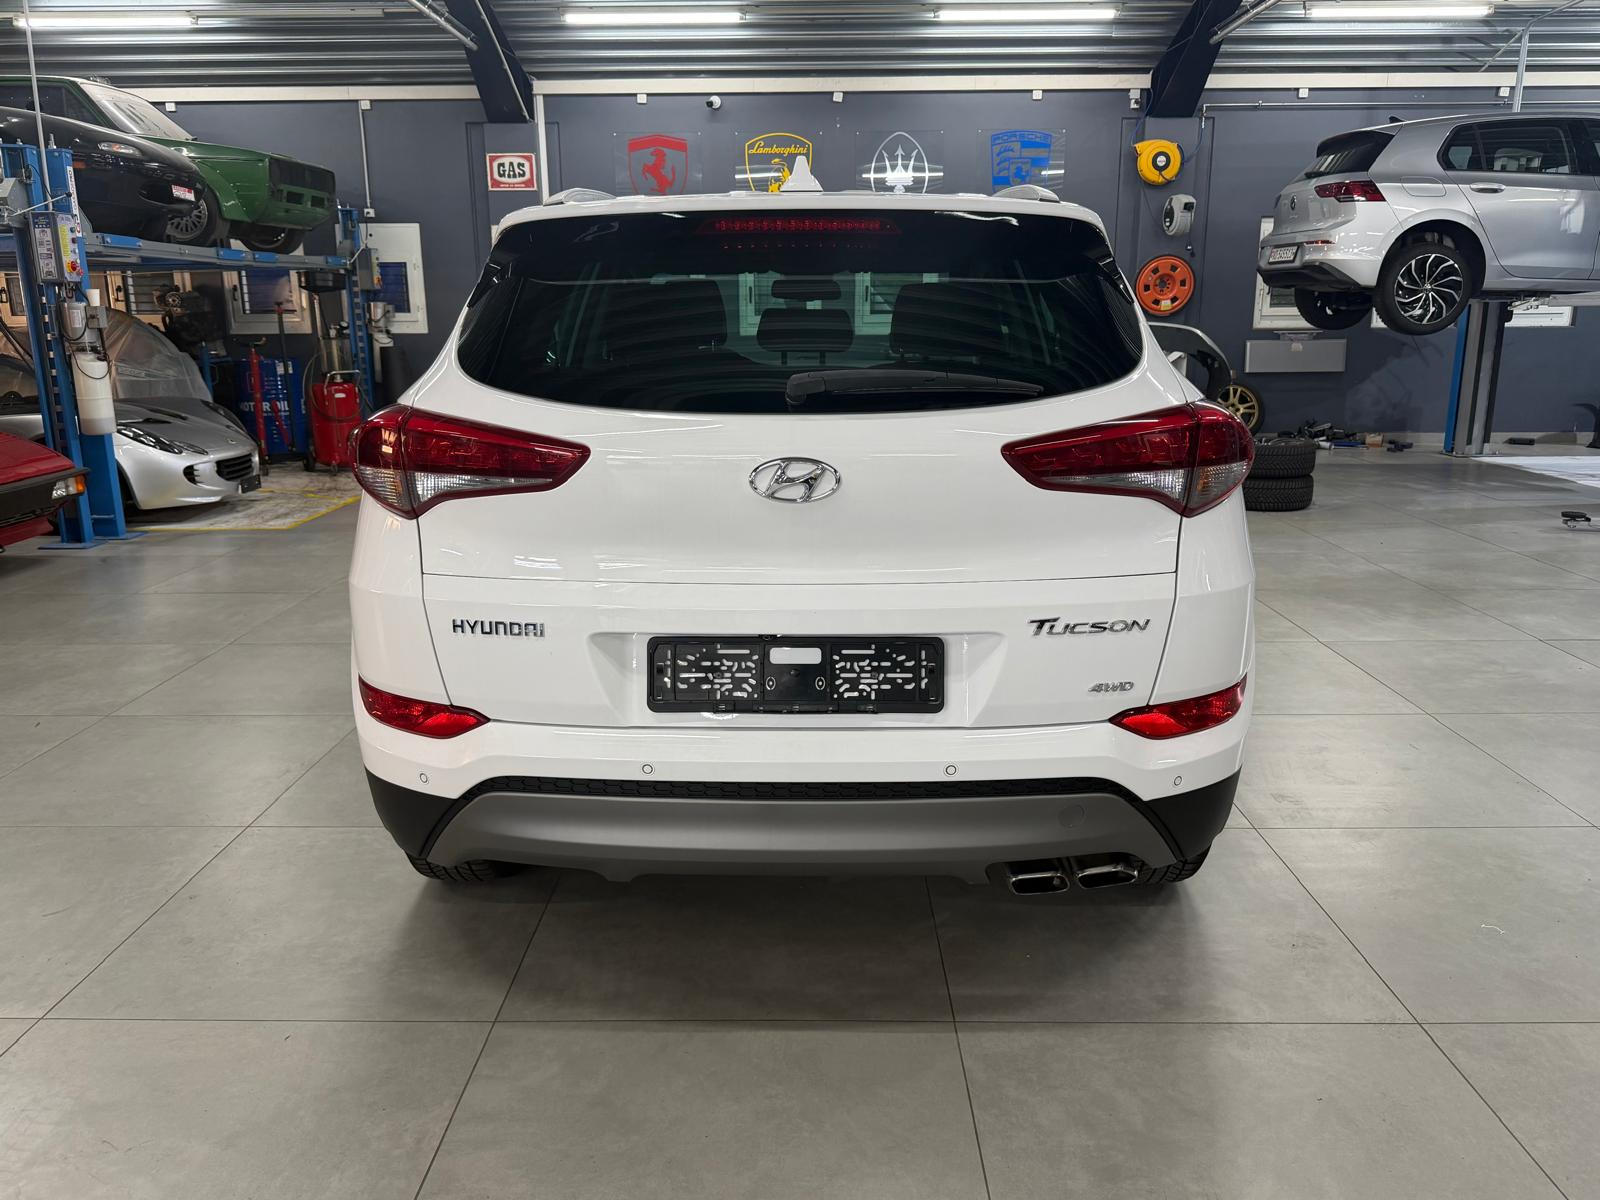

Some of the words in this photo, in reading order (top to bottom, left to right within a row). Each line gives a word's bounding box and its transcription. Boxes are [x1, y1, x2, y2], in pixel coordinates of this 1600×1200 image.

[748, 141, 809, 156] Lamborghini
[497, 161, 526, 179] GAS
[452, 618, 545, 637] HYUNDAI
[1028, 616, 1151, 636] TUCSON
[1088, 681, 1135, 693] 4WD
